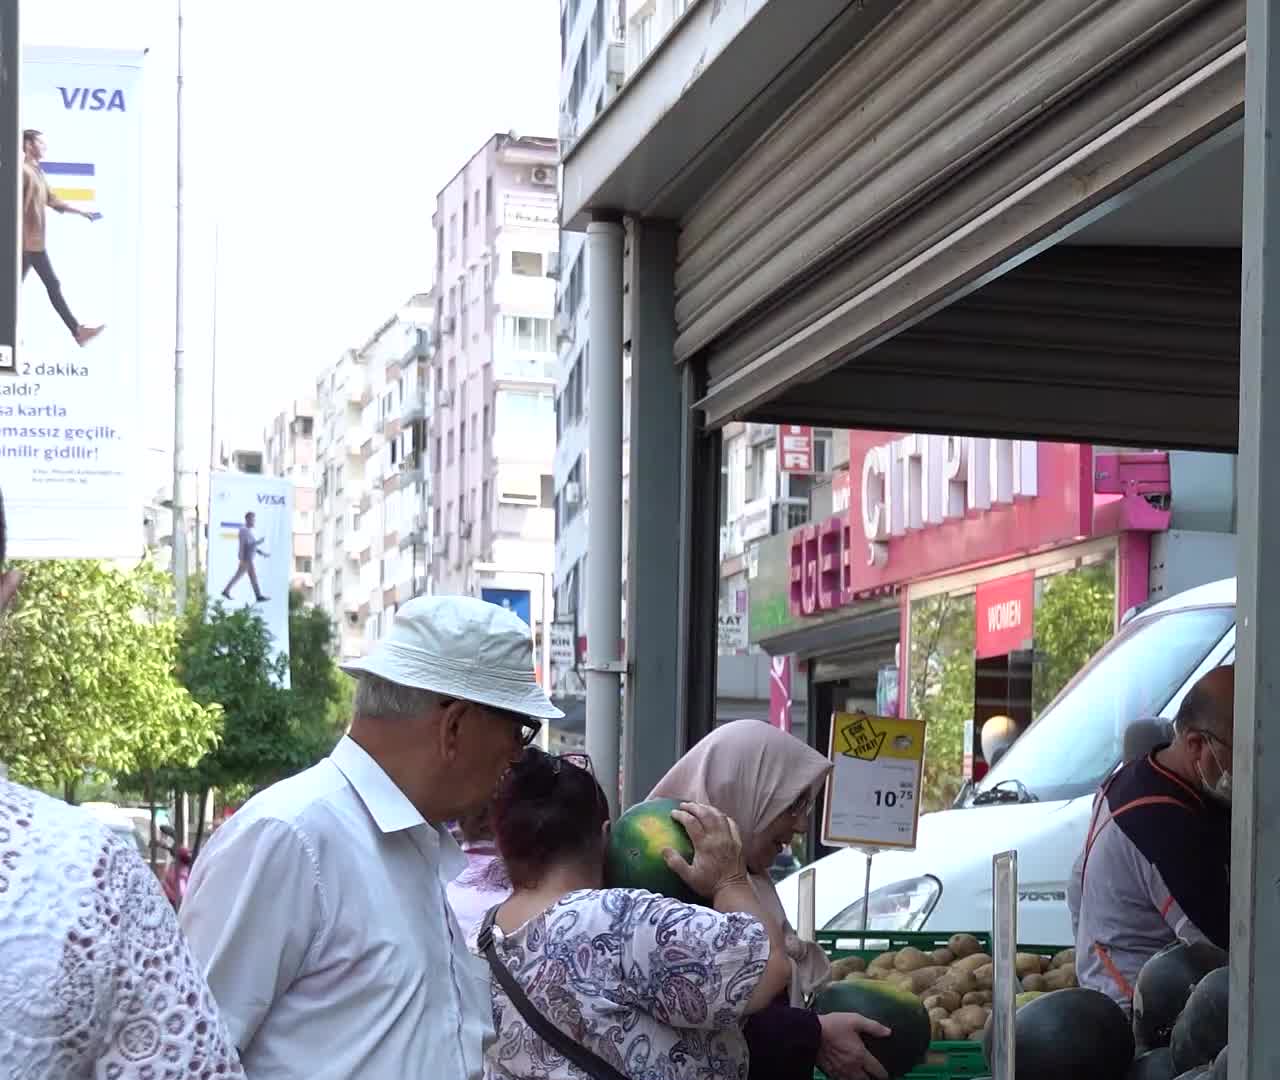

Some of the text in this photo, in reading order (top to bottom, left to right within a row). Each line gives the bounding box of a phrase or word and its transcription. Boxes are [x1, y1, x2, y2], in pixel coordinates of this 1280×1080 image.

[56, 86, 126, 113] VISA
[21, 362, 89, 377] 2 dakika
[0, 383, 41, 397] aldı?
[18, 403, 67, 417] kartla
[0, 426, 60, 438] massız
[256, 493, 286, 505] VISA
[987, 599, 1022, 633] WOMEN
